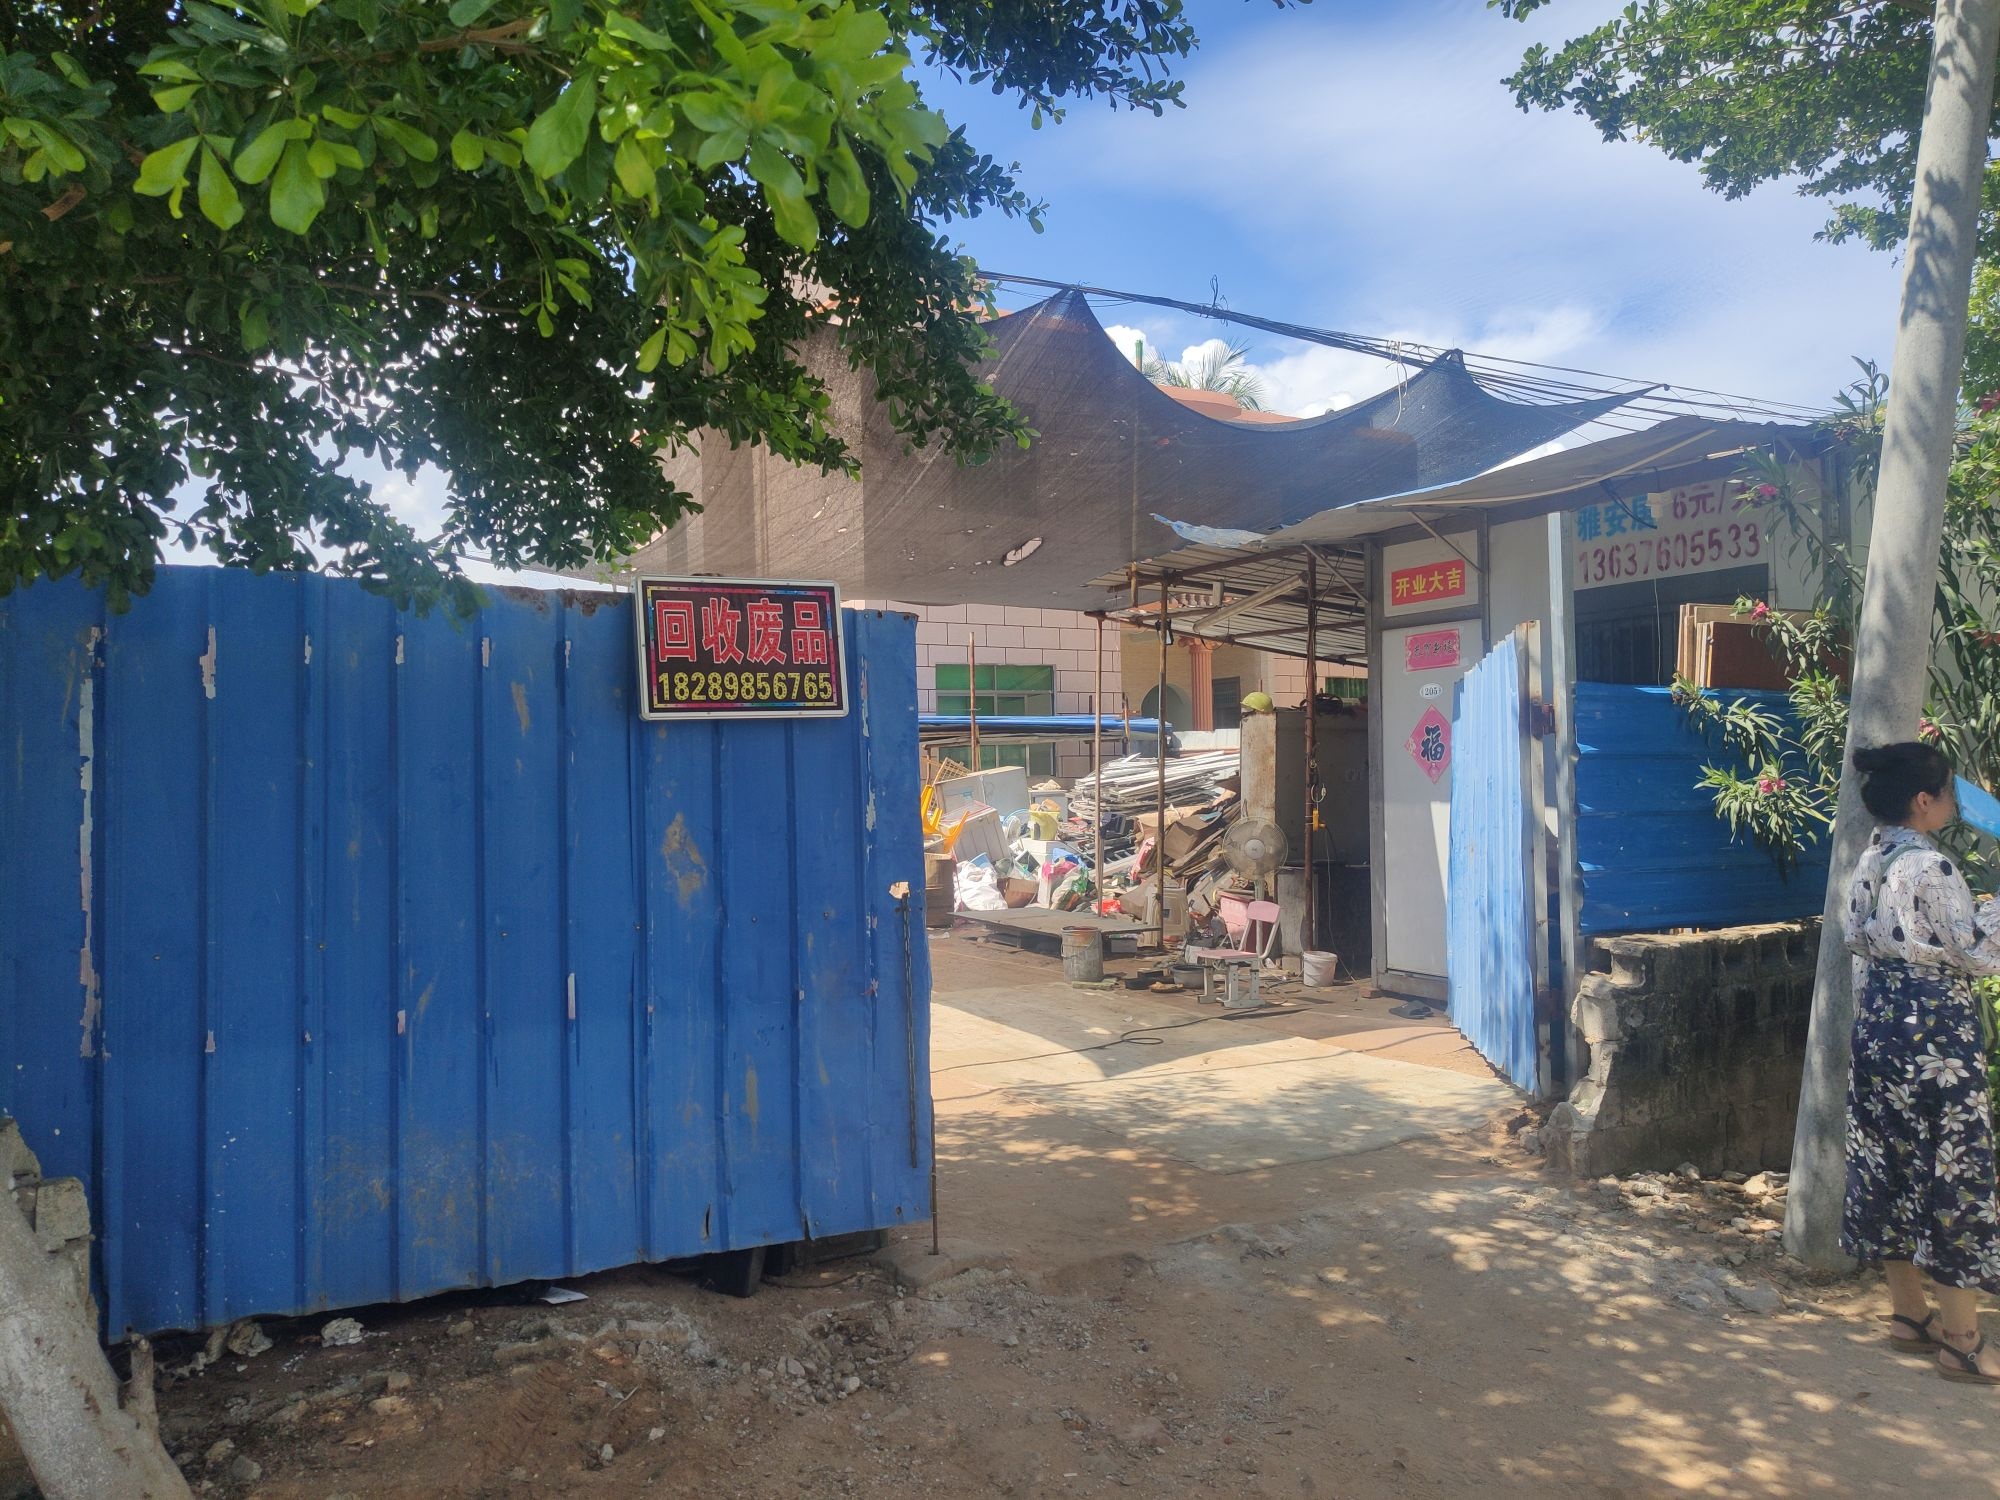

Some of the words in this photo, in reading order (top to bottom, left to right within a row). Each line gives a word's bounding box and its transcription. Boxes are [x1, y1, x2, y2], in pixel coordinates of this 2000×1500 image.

[1579, 523, 1760, 583] 13637605533
[1395, 567, 1462, 598] 开业大吉
[655, 597, 828, 665] 回收废品
[658, 672, 832, 700] 18289856765
[1424, 686, 1438, 696] 205
[1420, 724, 1445, 762] 福
